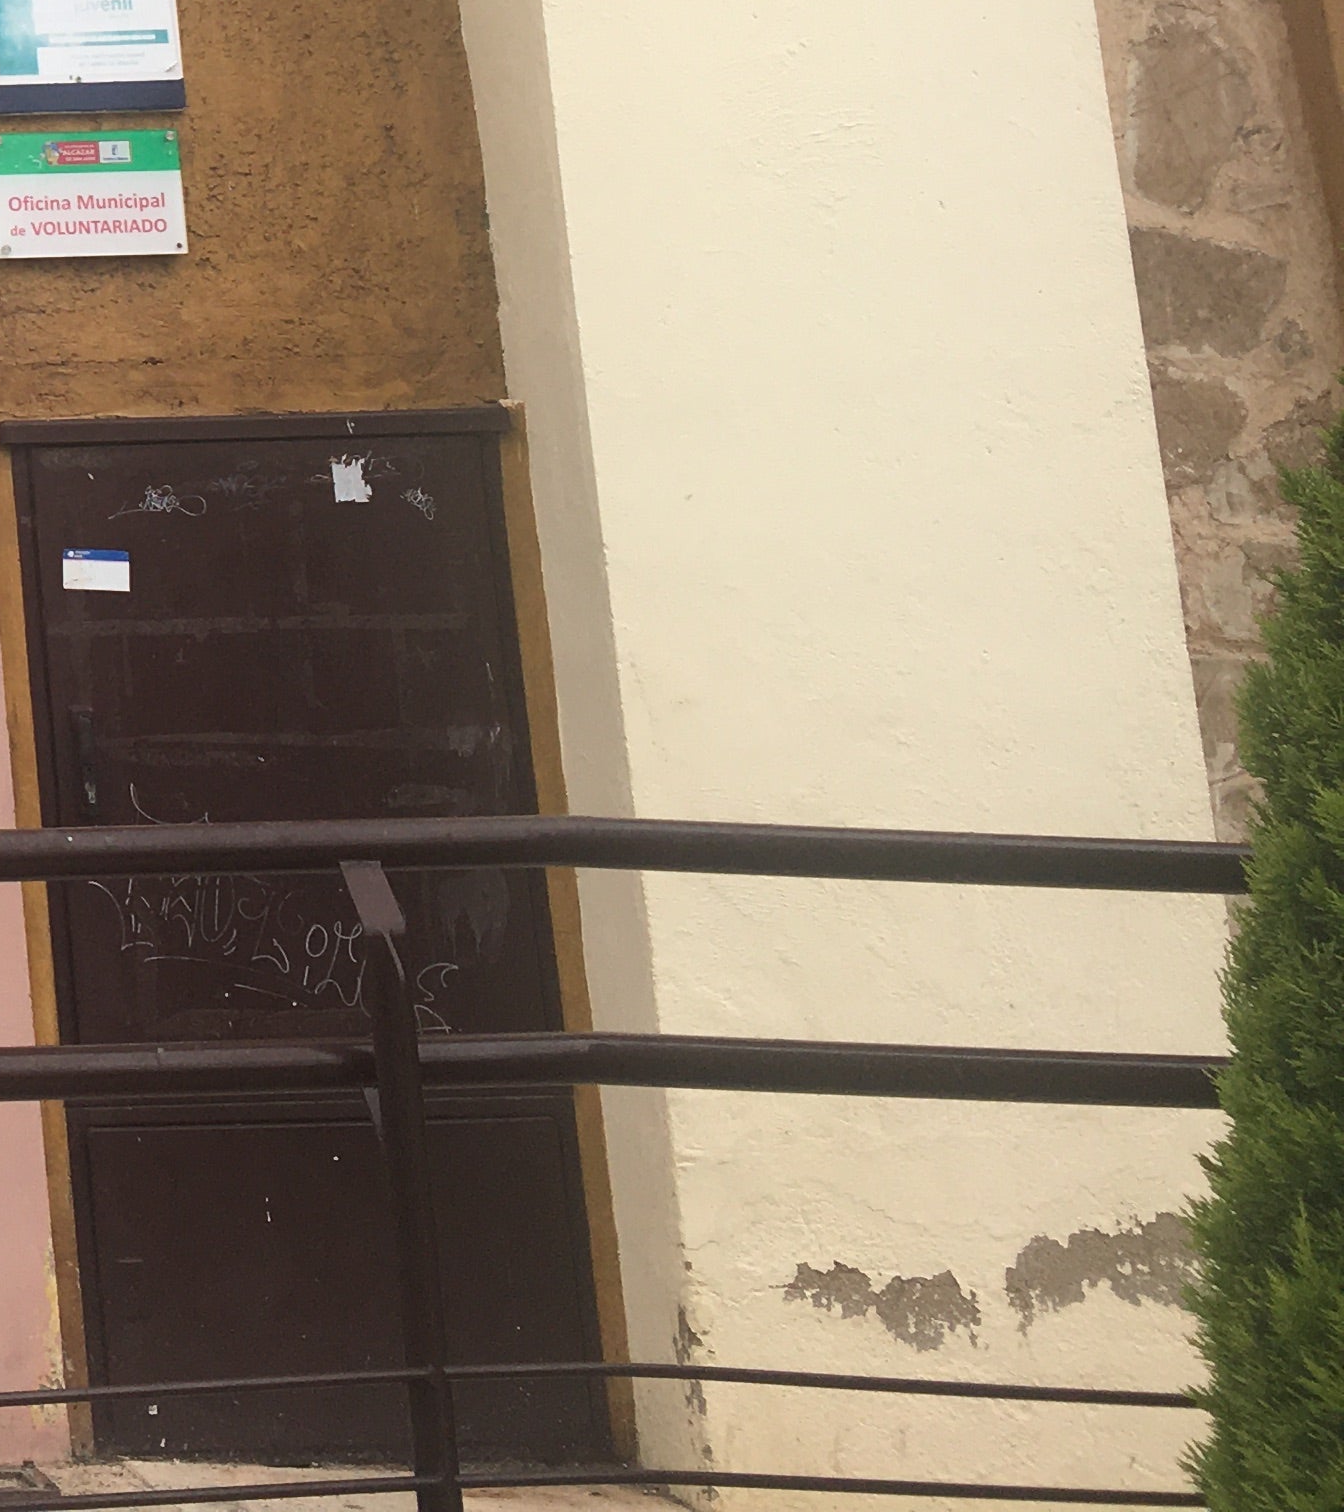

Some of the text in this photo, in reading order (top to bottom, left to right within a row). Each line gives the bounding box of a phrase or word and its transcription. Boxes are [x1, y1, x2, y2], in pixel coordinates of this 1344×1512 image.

[8, 192, 165, 212] Oficina Municipal
[10, 219, 168, 237] de VOLUNTARIADO
